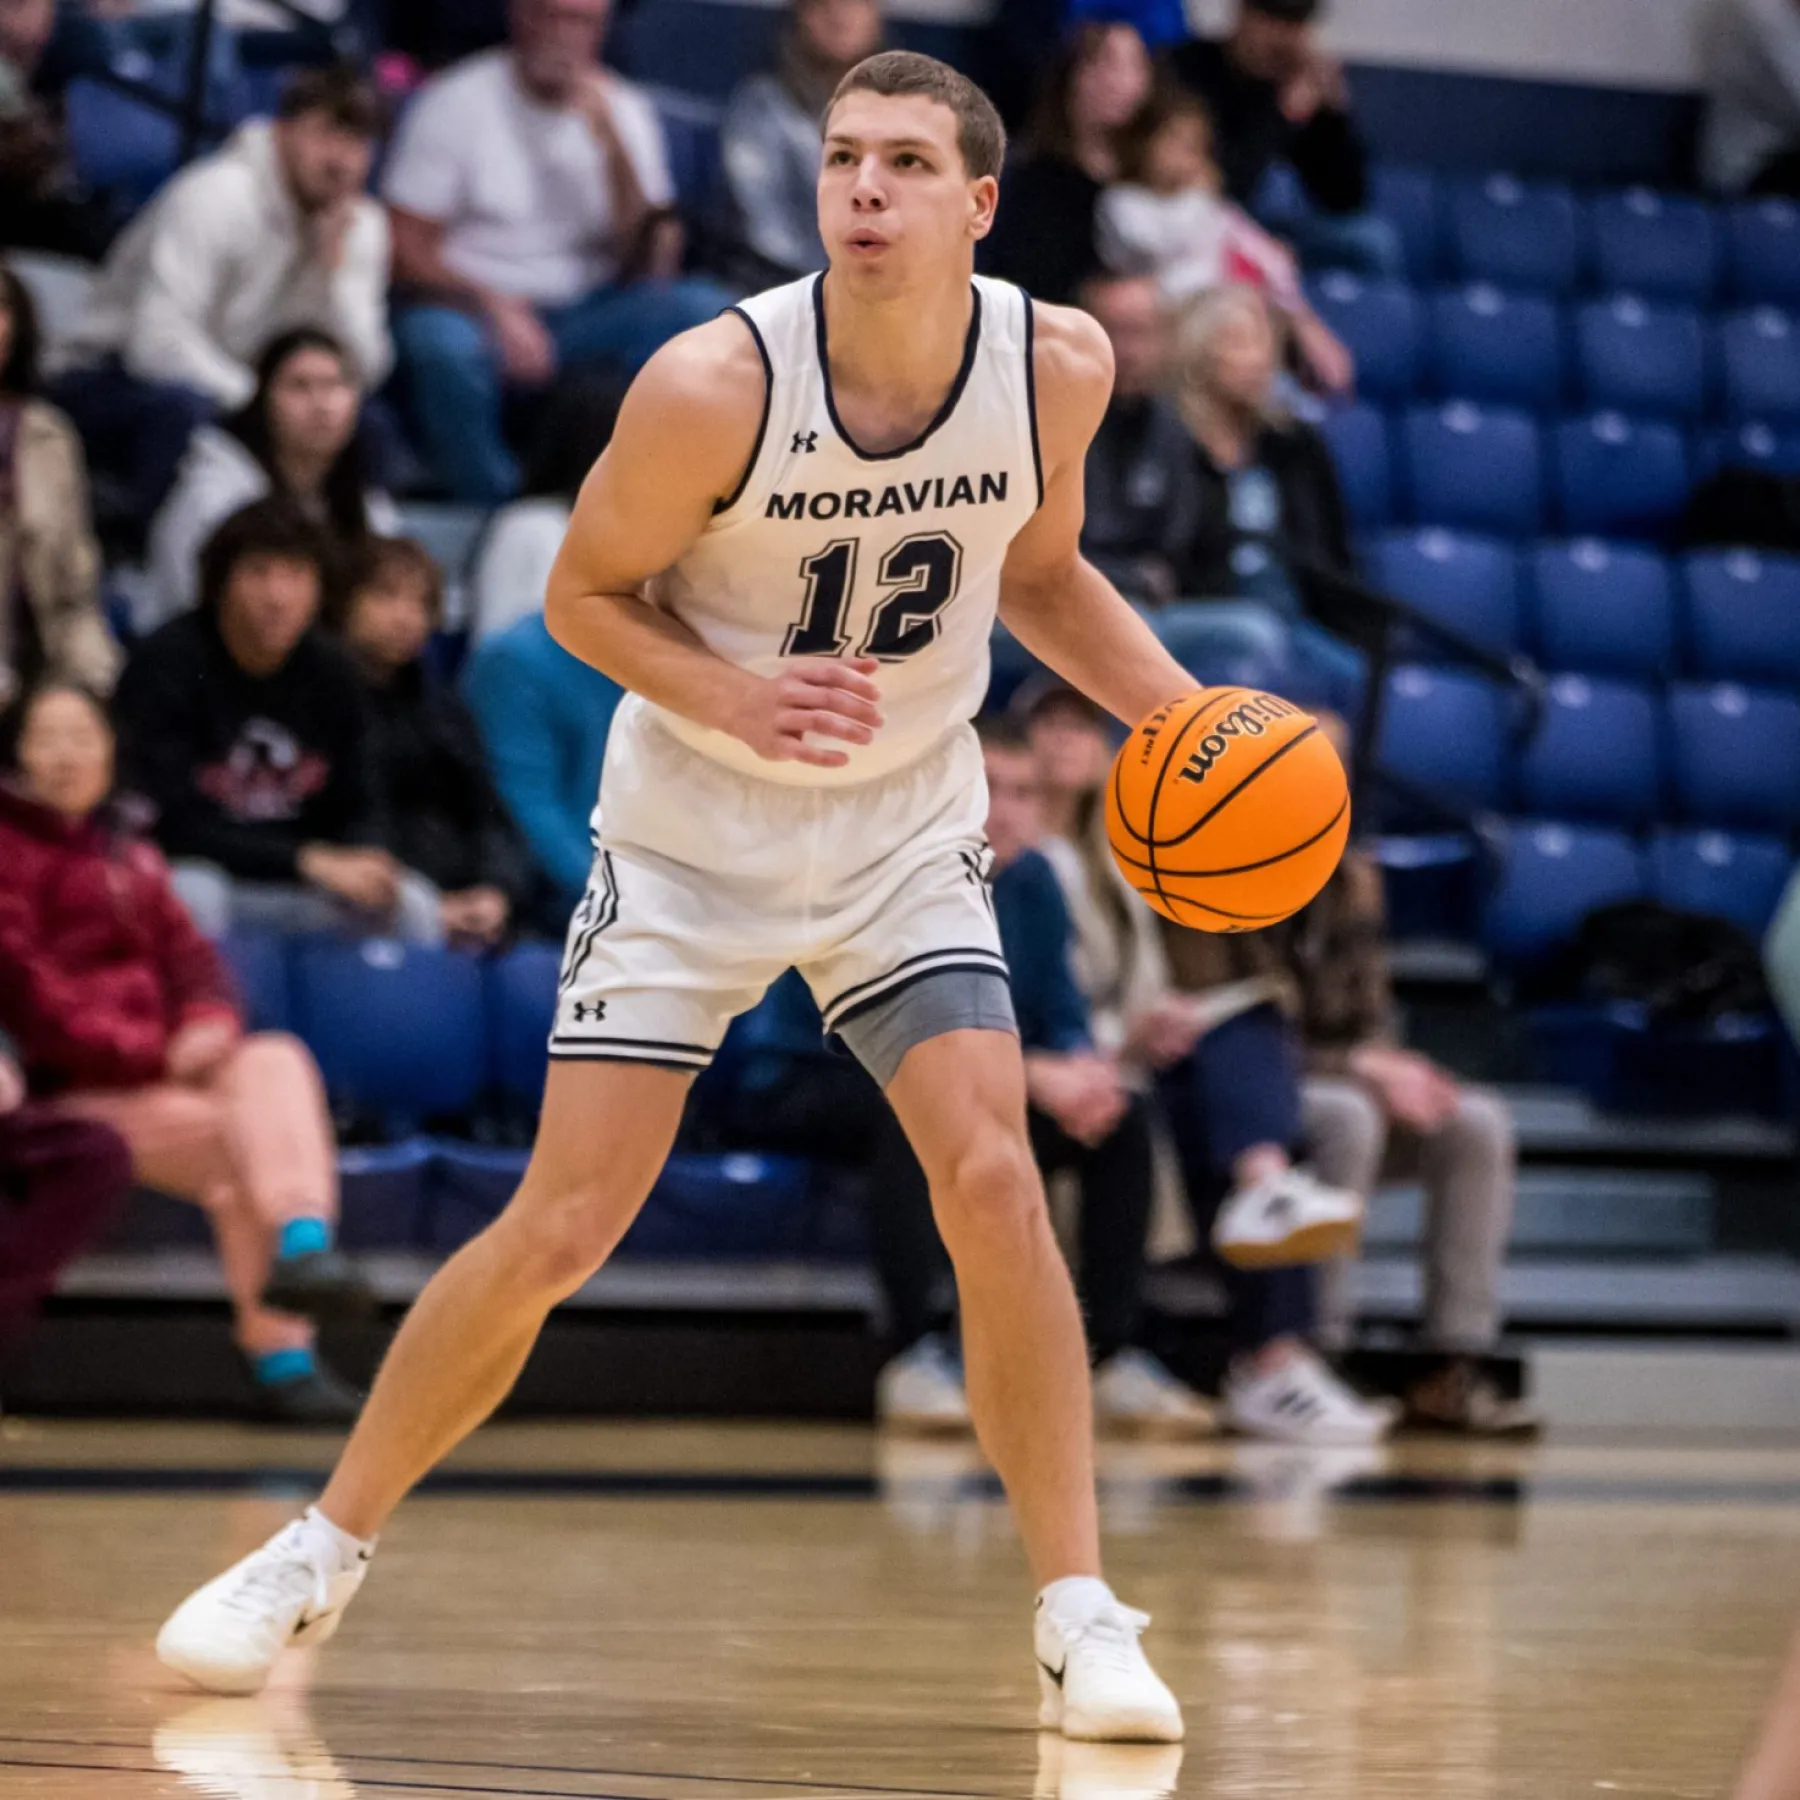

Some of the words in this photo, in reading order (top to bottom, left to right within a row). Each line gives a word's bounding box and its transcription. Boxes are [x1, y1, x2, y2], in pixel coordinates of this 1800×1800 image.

[764, 471, 1009, 521] MORAVIAN
[779, 529, 963, 663] 12
[1179, 694, 1299, 784] Wilson
